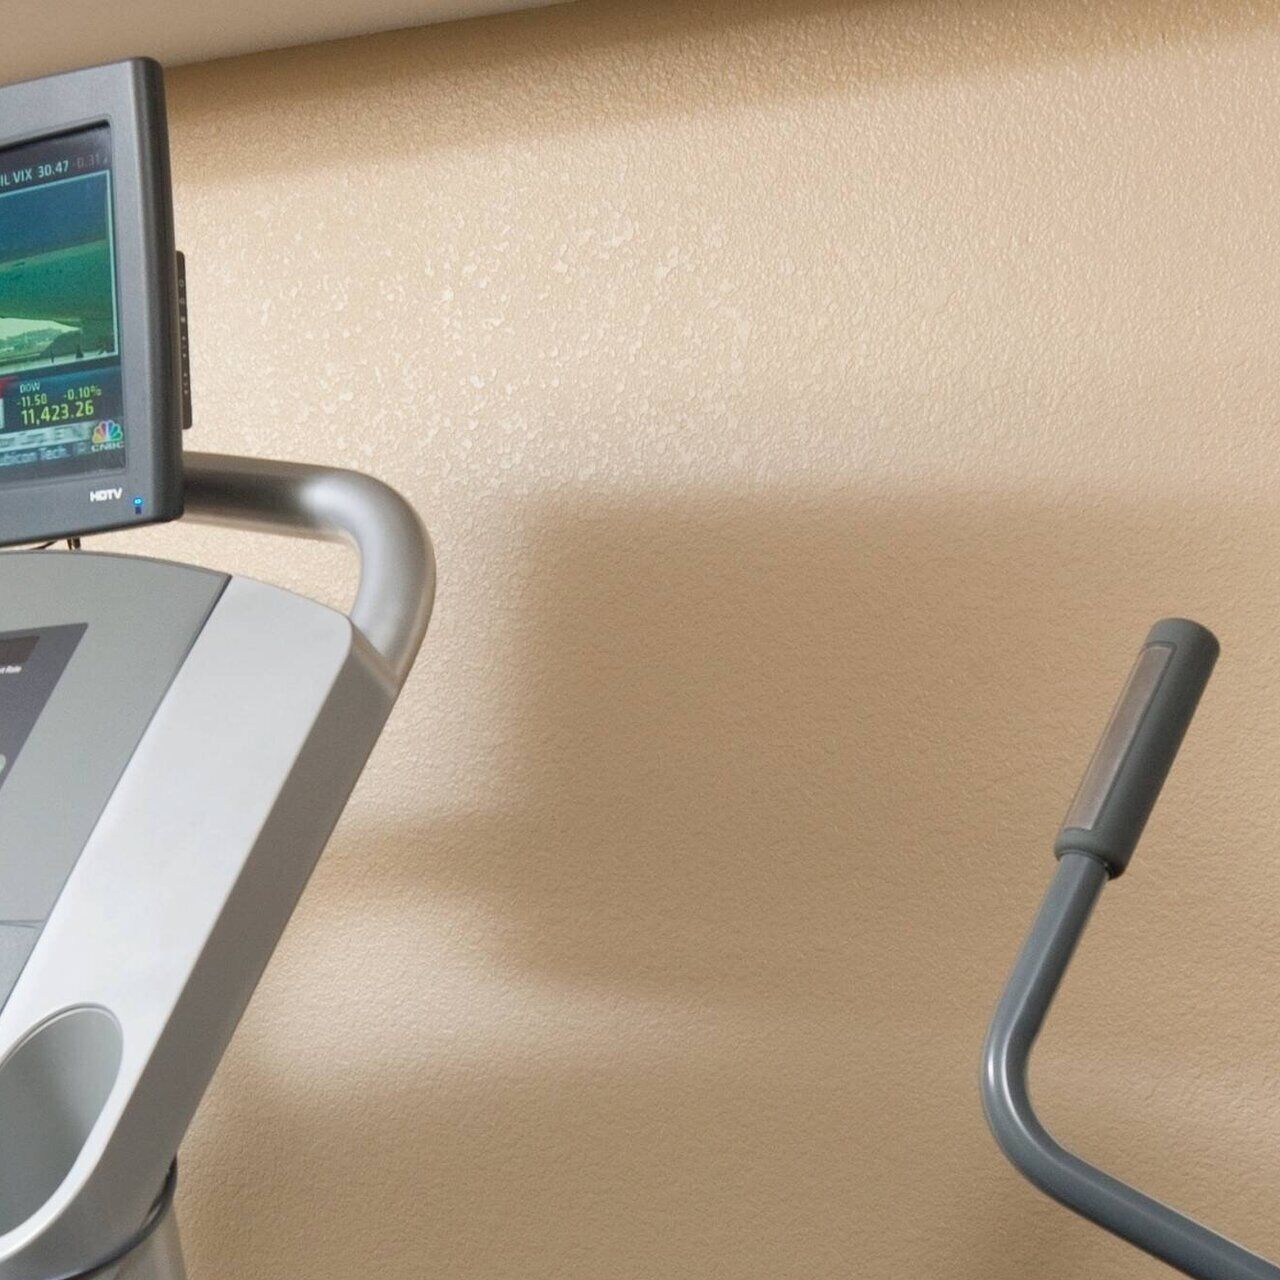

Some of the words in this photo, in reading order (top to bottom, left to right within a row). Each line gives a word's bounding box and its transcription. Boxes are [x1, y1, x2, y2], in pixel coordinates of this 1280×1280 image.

[13, 167, 33, 184] VIX
[37, 160, 70, 178] 30.47
[20, 399, 95, 426] 11,423.26
[89, 488, 123, 503] HDTV
